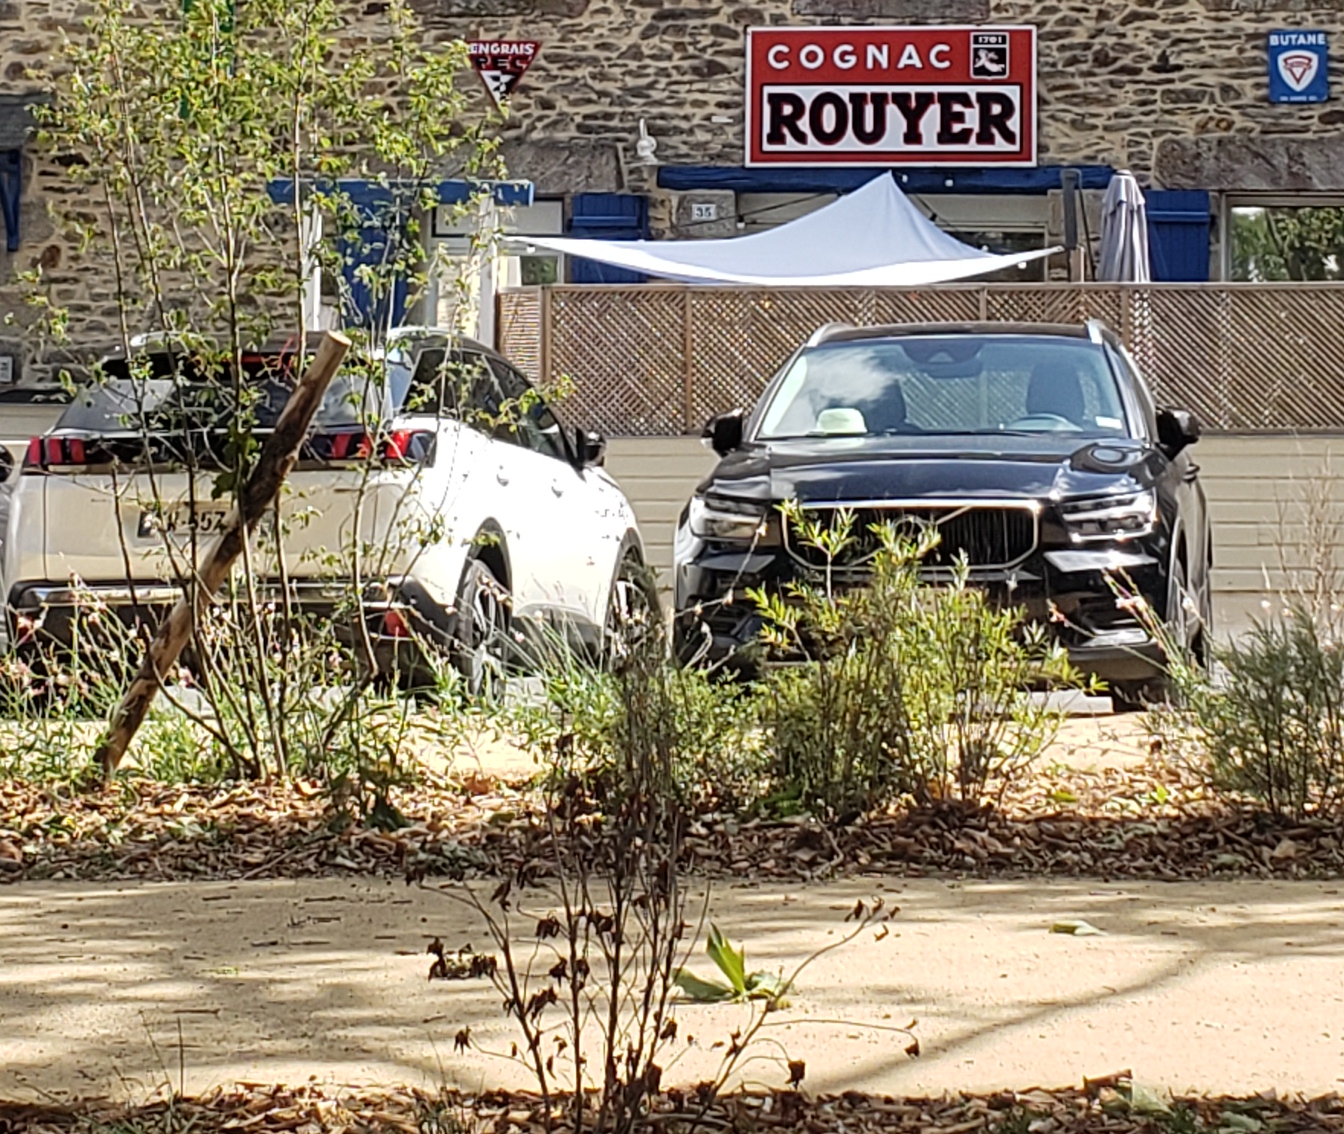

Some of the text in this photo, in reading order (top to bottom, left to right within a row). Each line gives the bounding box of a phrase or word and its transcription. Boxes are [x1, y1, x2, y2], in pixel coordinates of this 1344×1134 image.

[978, 36, 1003, 44] 1701
[1270, 33, 1326, 46] BUTANE
[468, 43, 535, 55] ENGRAIS
[768, 44, 951, 69] COGNAC
[766, 91, 1017, 146] ROUYER
[696, 206, 712, 217] 35
